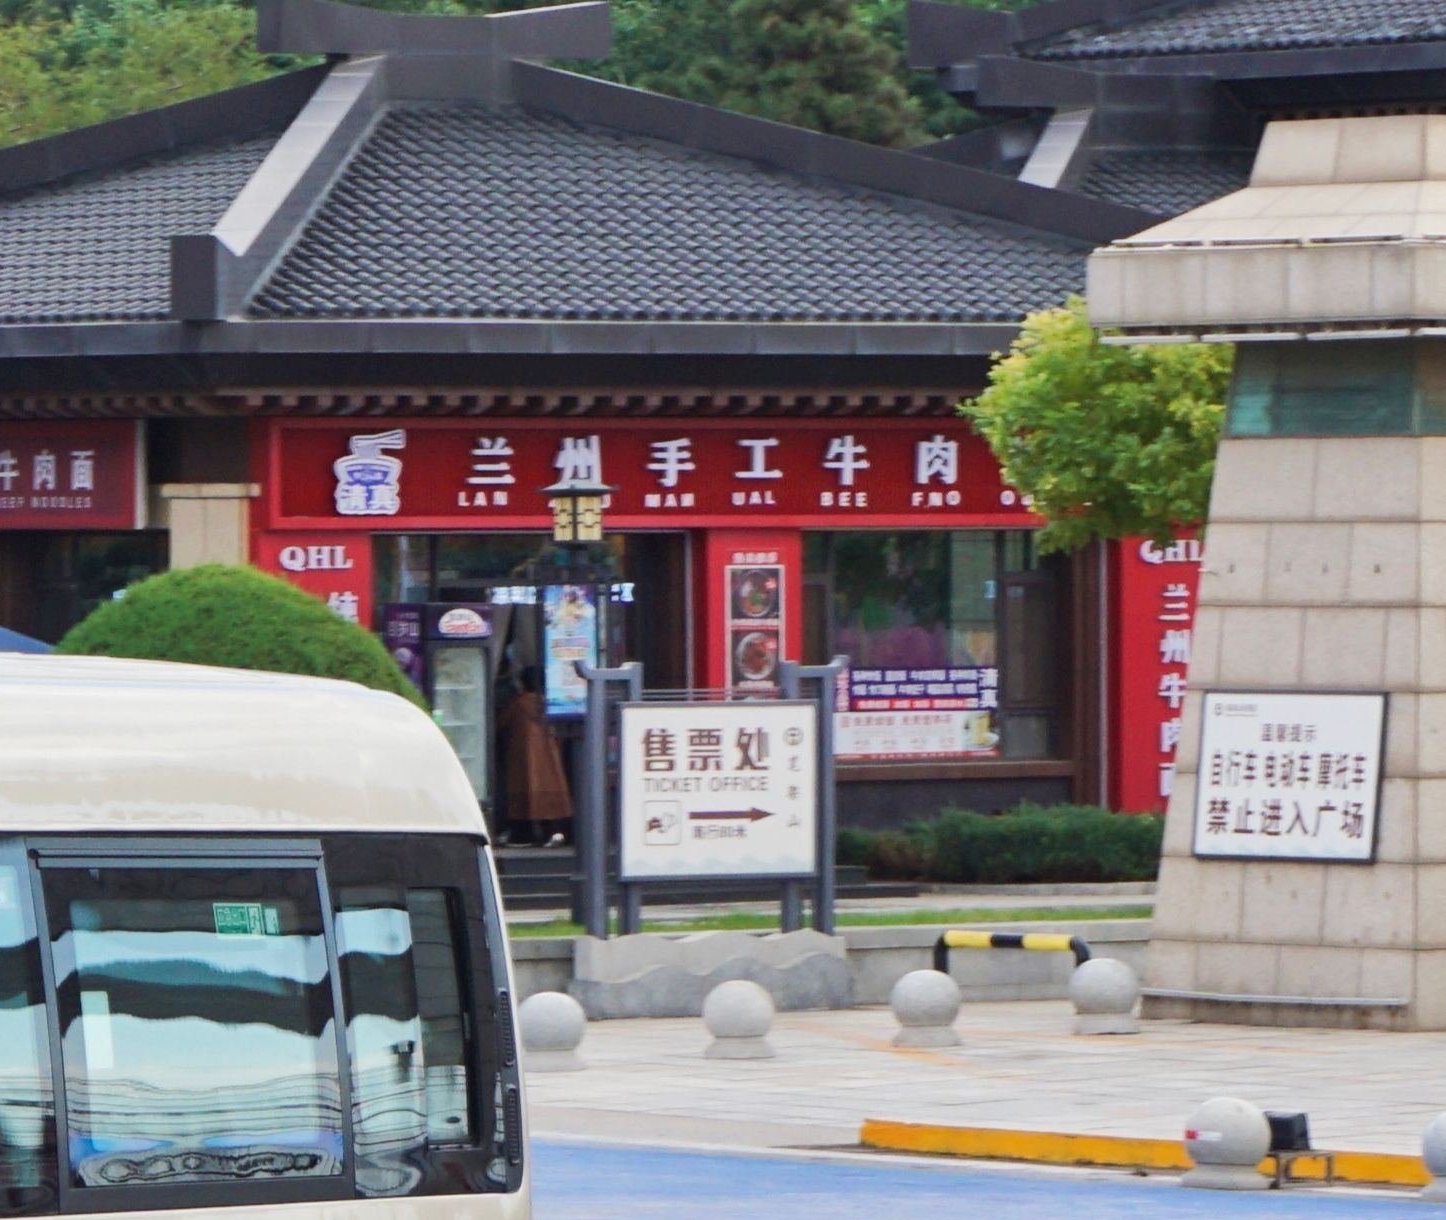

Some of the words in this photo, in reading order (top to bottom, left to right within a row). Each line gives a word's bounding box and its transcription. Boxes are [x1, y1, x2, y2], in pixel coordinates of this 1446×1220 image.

[279, 545, 354, 571] QHL
[641, 727, 770, 772] 售票处
[643, 777, 703, 793] TICKET
[709, 776, 769, 792] OFFICE
[1208, 797, 1366, 838] 禁止进入广场
